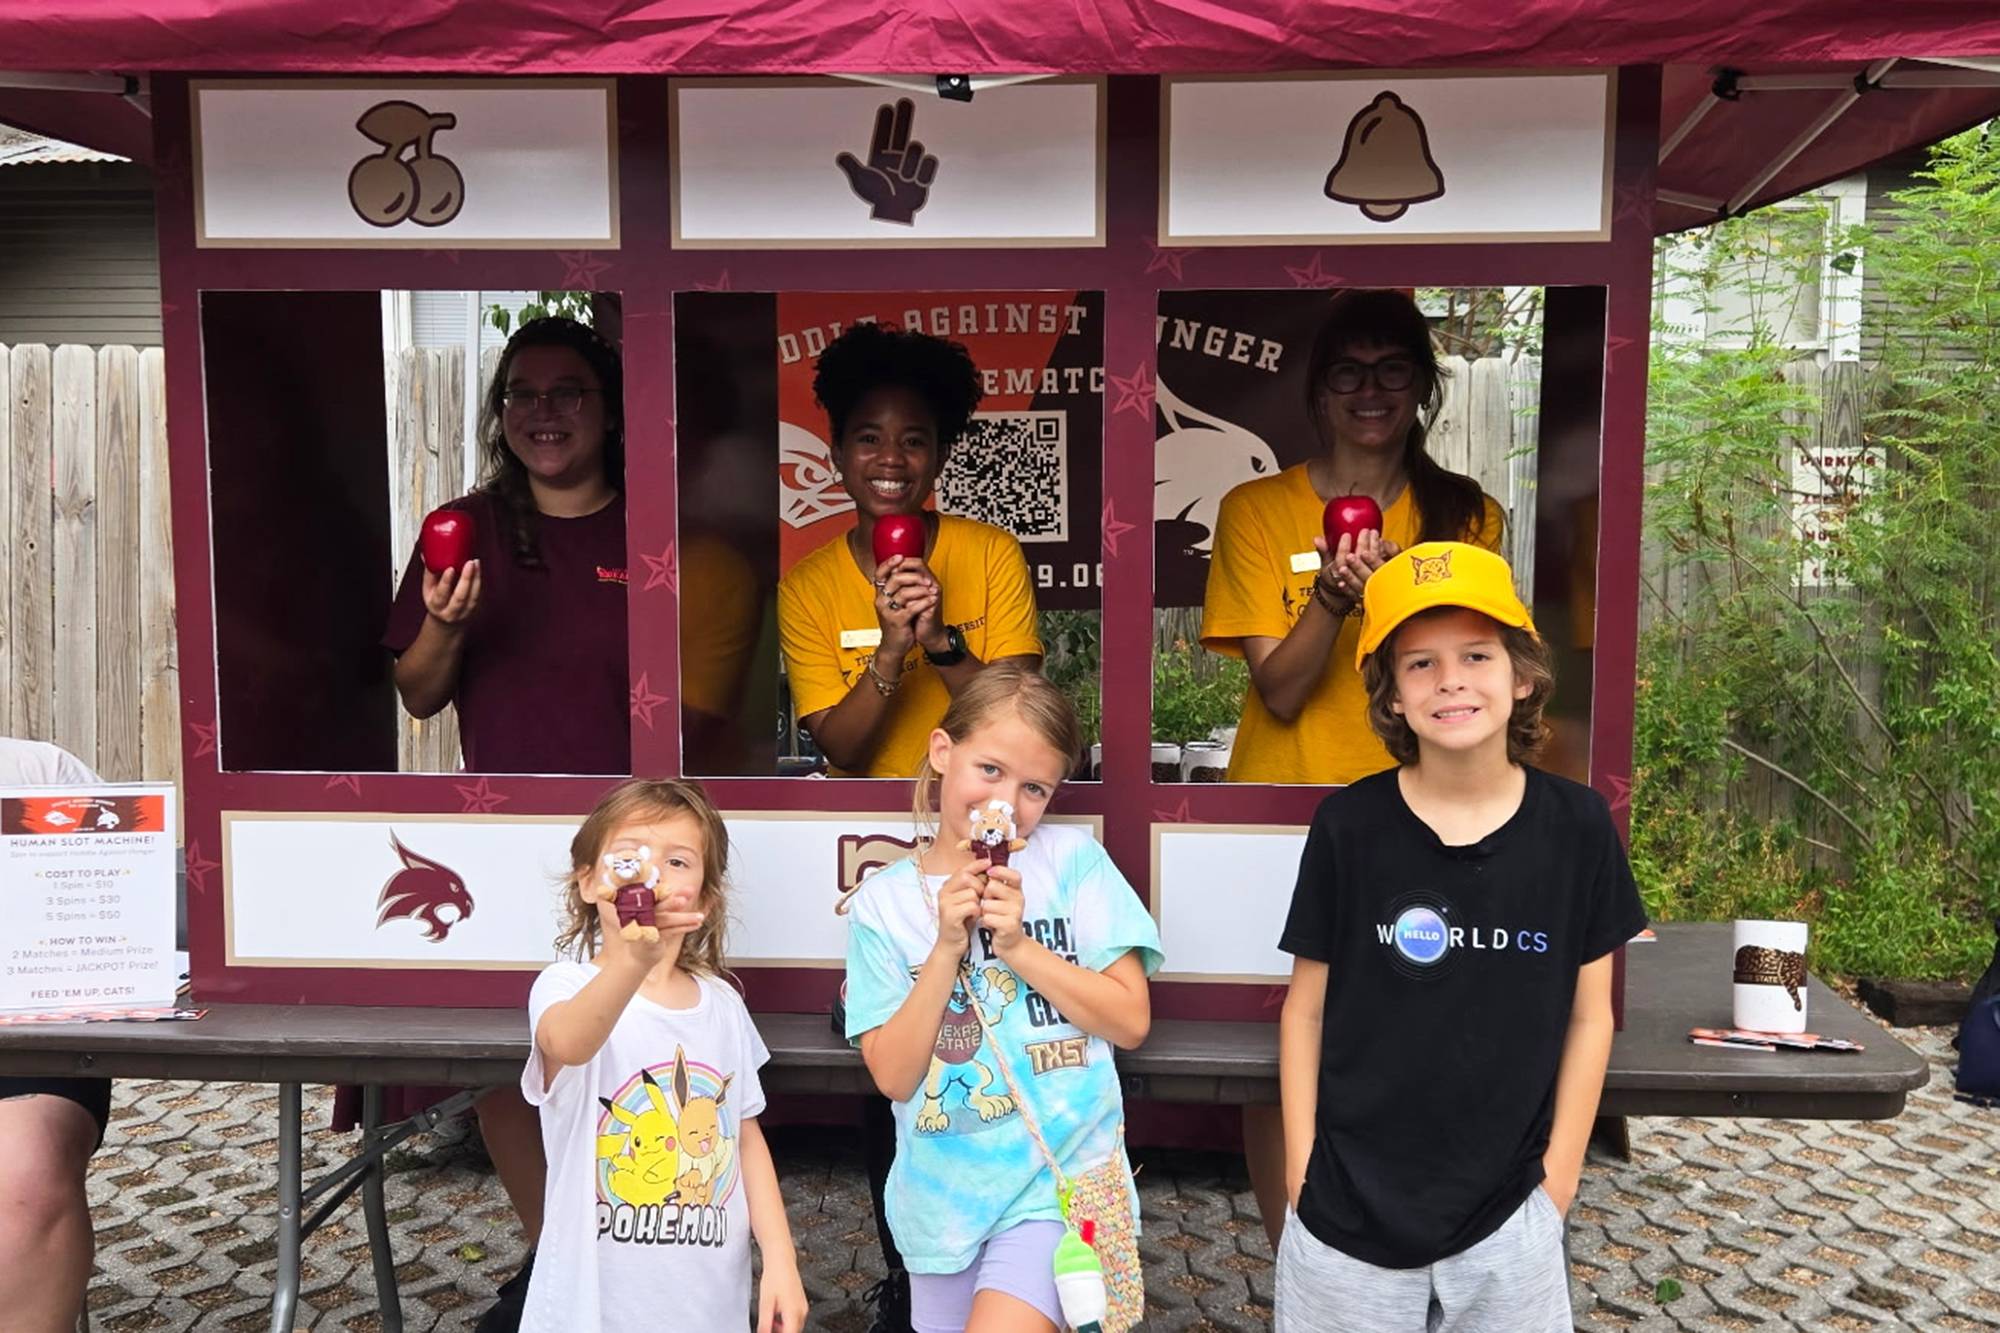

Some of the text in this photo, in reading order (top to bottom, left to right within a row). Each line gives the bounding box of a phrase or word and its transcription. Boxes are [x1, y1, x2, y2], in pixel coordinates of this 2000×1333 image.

[904, 304, 1087, 336] AGAINST
[10, 835, 155, 847] HUMAN SLOT MACHINE!
[45, 868, 120, 878] COST TO PLAY
[46, 896, 54, 905] 3
[50, 935, 116, 945] HOW TO WIN
[1404, 928, 1441, 942] HELLO
[1517, 930, 1548, 953] CS
[12, 950, 19, 959] 2
[22, 949, 69, 958] Matches
[126, 945, 154, 954] Prize
[7, 966, 15, 975] 3
[17, 965, 63, 974] Matches
[76, 962, 126, 972] JACKPOT
[31, 989, 59, 999] FEED
[103, 986, 135, 996] CATS!
[936, 1033, 981, 1050] STATE
[1027, 1037, 1090, 1075] TXST
[597, 1191, 728, 1248] POKÉMON
